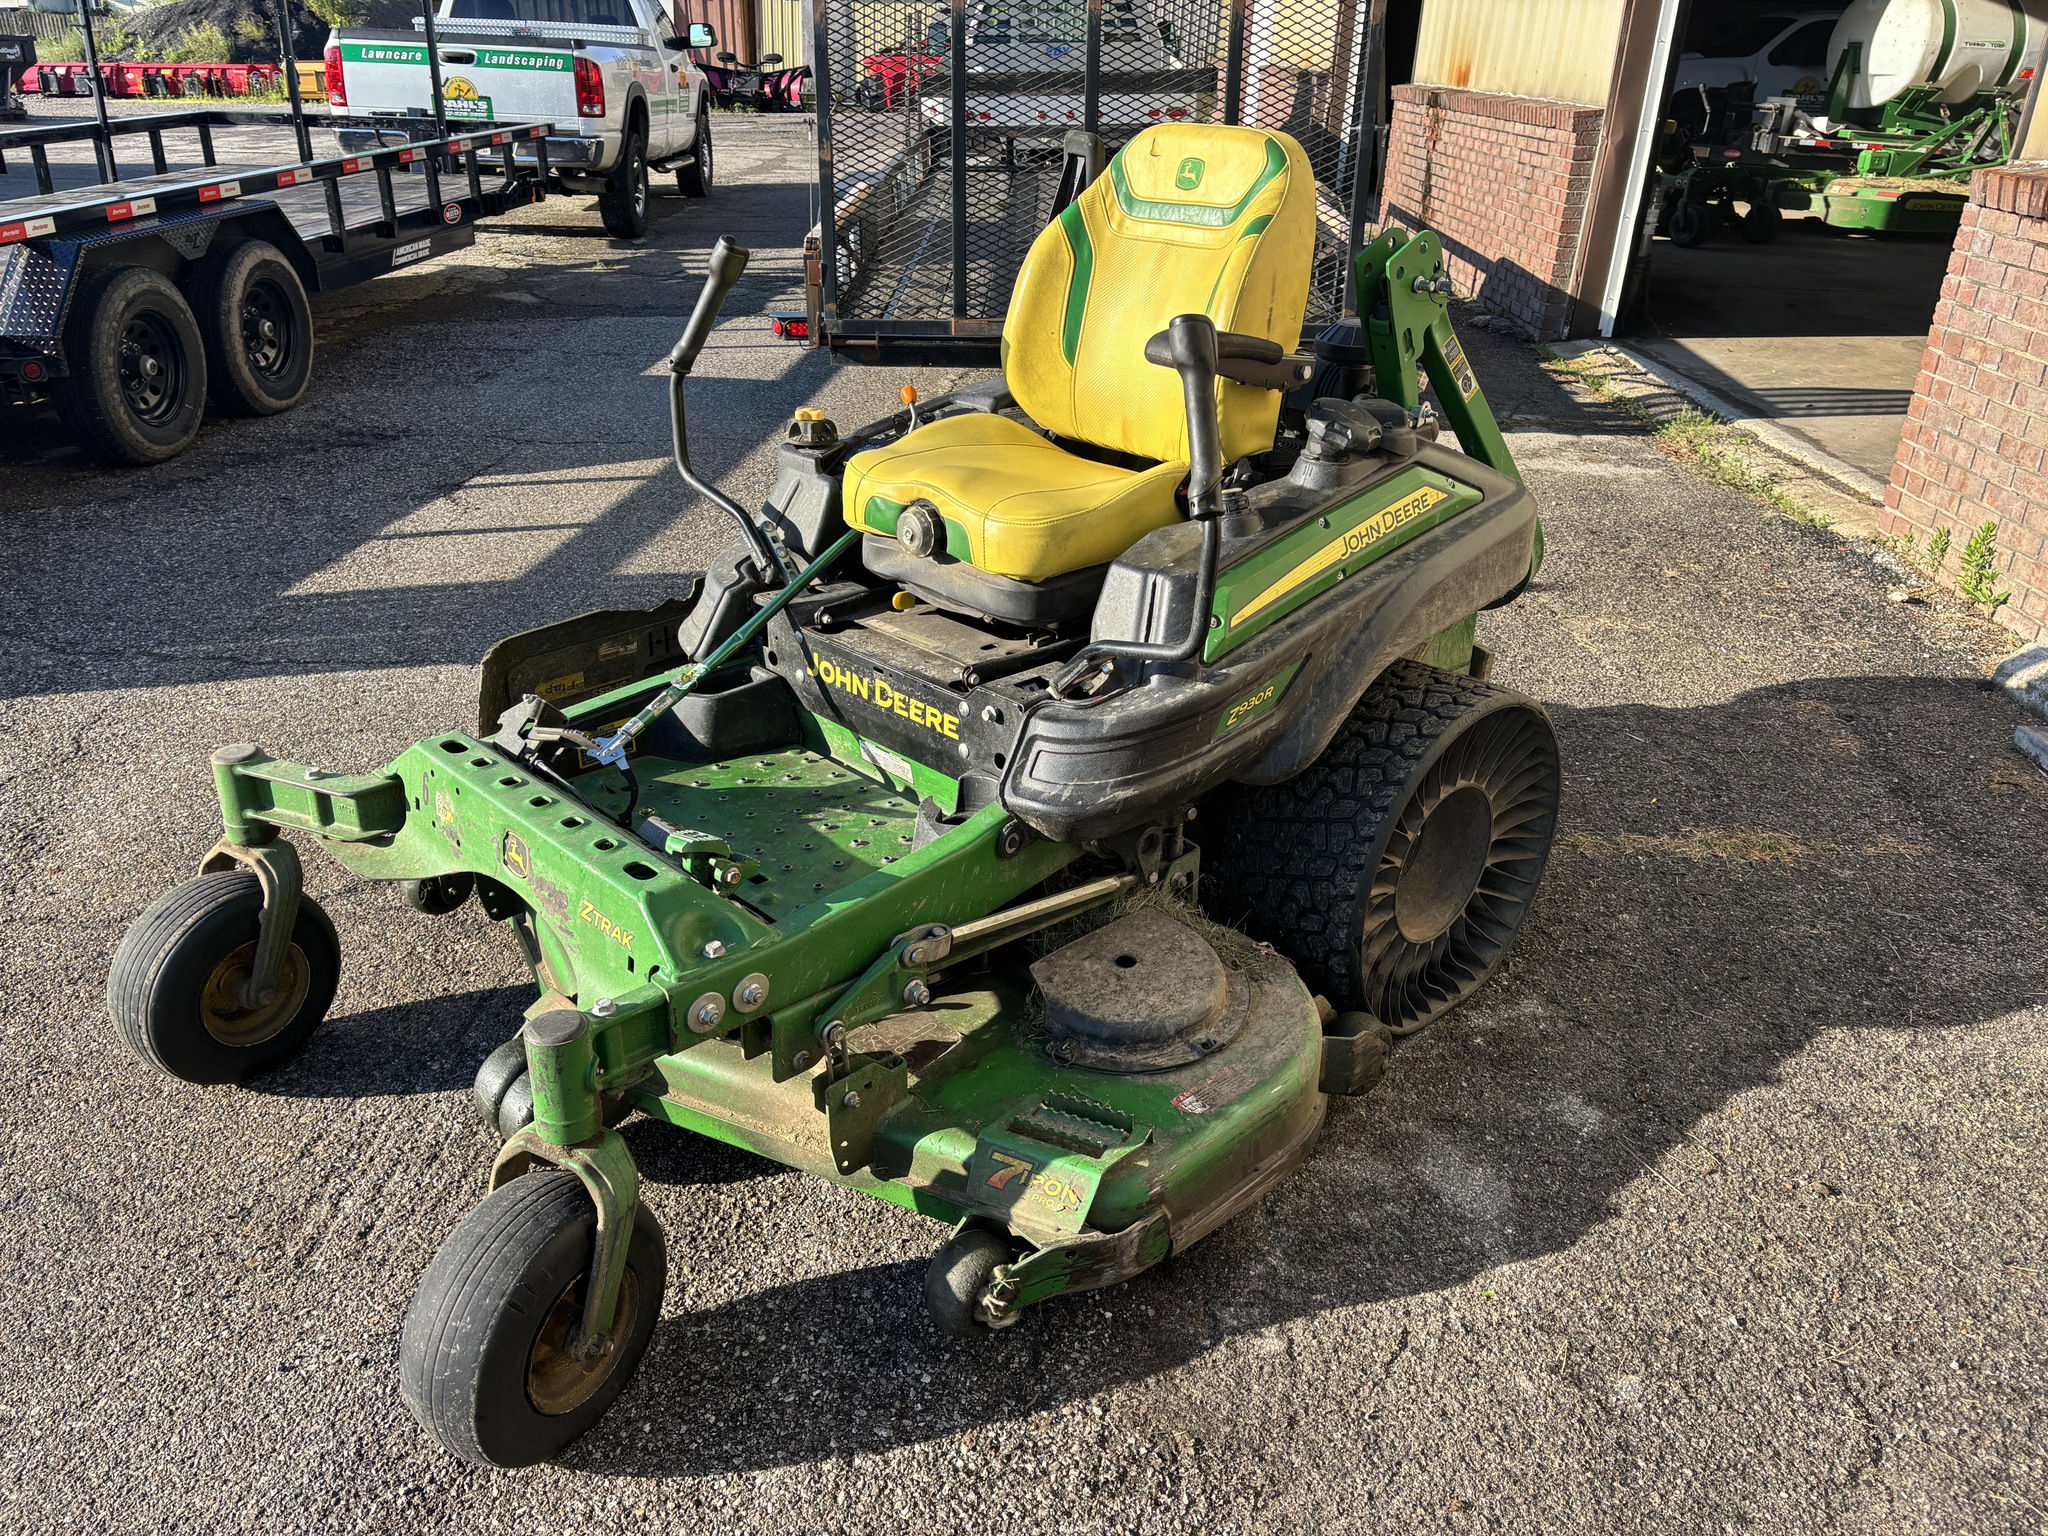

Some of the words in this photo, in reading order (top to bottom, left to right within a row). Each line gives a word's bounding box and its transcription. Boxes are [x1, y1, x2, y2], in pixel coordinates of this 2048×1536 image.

[361, 47, 423, 61] Lawncare
[484, 52, 564, 69] Landscaping
[1910, 202, 1935, 211] JOHN
[396, 241, 419, 256] AMERICAN
[418, 238, 431, 249] MADE
[1341, 520, 1381, 558] JOHN
[1381, 492, 1432, 531] DEERE
[807, 652, 869, 700] JOHN
[874, 678, 960, 741] DEERE
[1226, 685, 1275, 727] Z930R
[580, 897, 635, 953] ZTRAK
[1031, 1194, 1056, 1208] PRO
